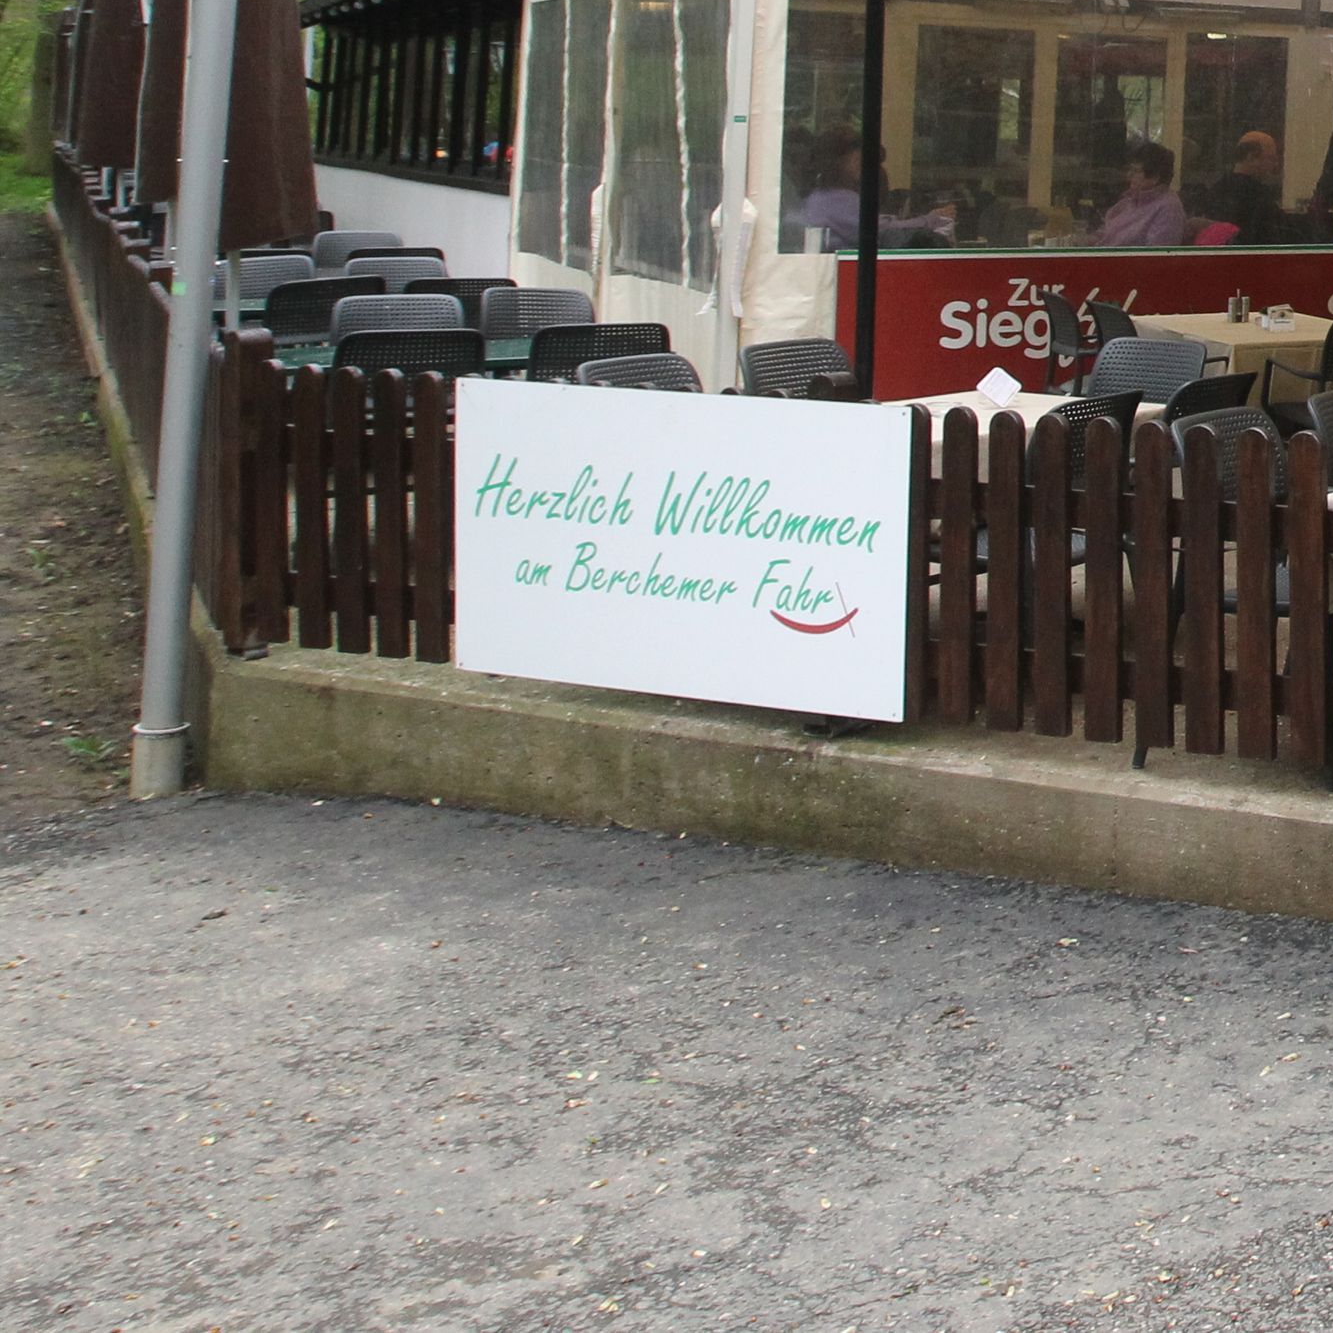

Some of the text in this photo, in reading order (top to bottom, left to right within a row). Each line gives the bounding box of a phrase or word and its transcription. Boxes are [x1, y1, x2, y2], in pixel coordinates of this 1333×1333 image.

[473, 452, 883, 554] Herzlich Willkommen
[513, 556, 553, 588] am
[564, 540, 738, 606] Berchemer
